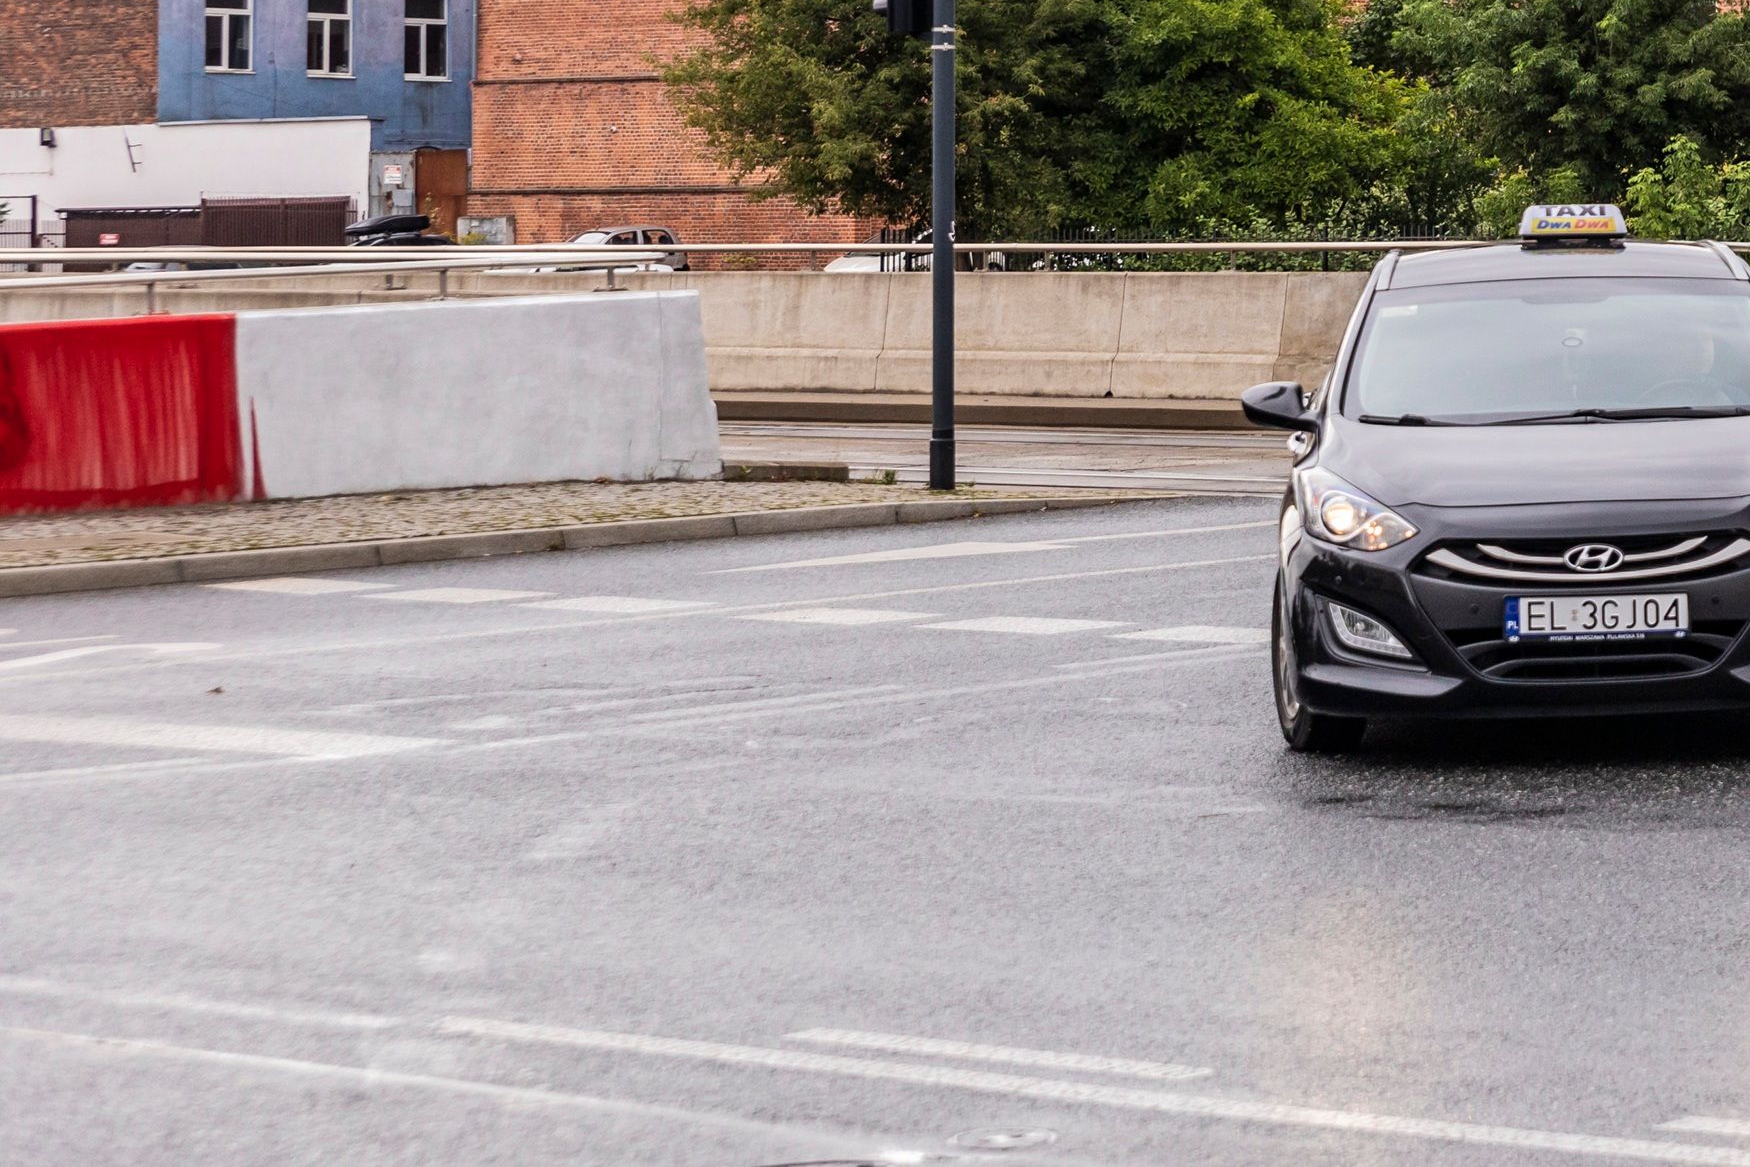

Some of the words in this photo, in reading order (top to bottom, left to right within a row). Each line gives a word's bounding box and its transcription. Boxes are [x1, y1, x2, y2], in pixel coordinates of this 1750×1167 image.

[1539, 205, 1606, 217] TAXI
[1527, 600, 1568, 631] EL
[1582, 598, 1680, 630] 3GJ04
[1506, 620, 1519, 629] PL
